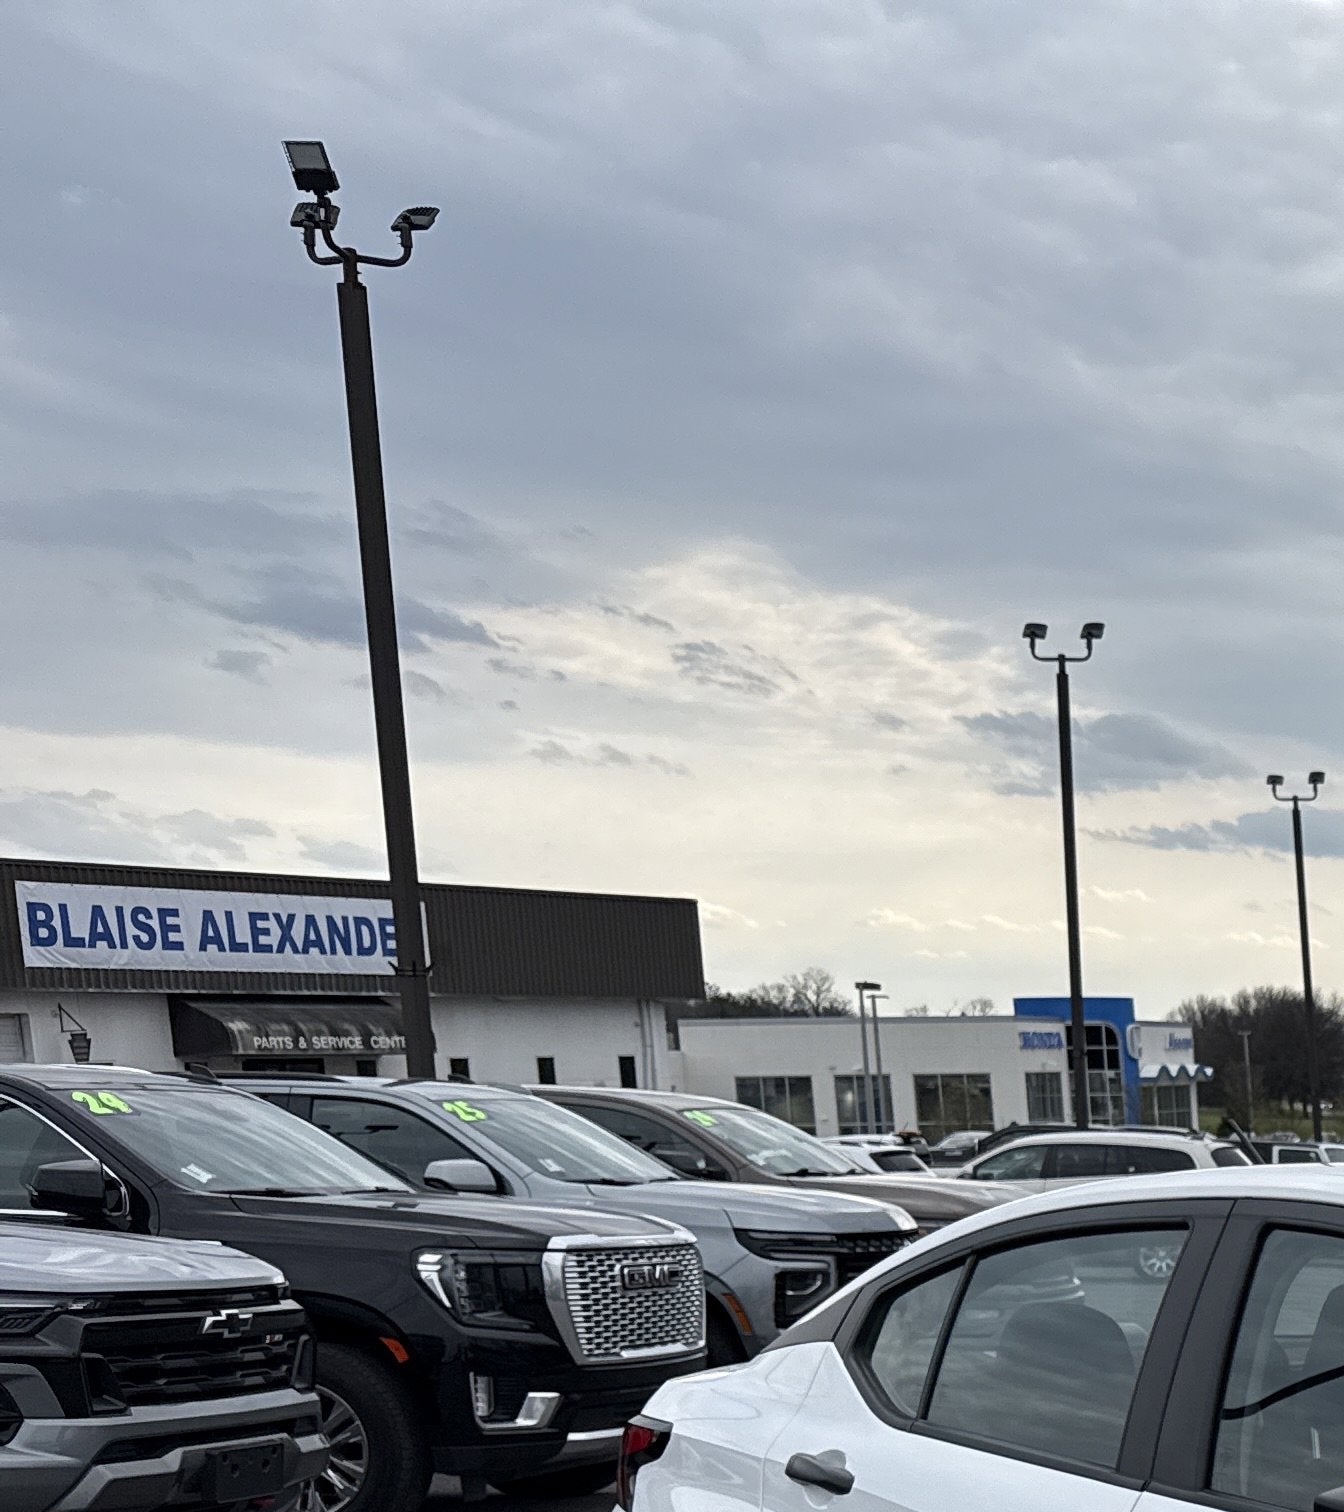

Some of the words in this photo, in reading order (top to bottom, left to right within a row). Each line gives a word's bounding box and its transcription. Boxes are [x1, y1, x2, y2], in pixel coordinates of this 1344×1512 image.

[26, 901, 185, 952] BLAISE
[199, 909, 398, 958] ALEXANDE
[253, 1036, 294, 1049] PARTS
[299, 1036, 307, 1049] &
[312, 1036, 364, 1049] SERVICE
[370, 1035, 406, 1049] CENT
[442, 1100, 487, 1121] 25
[623, 1265, 680, 1289] GMC
